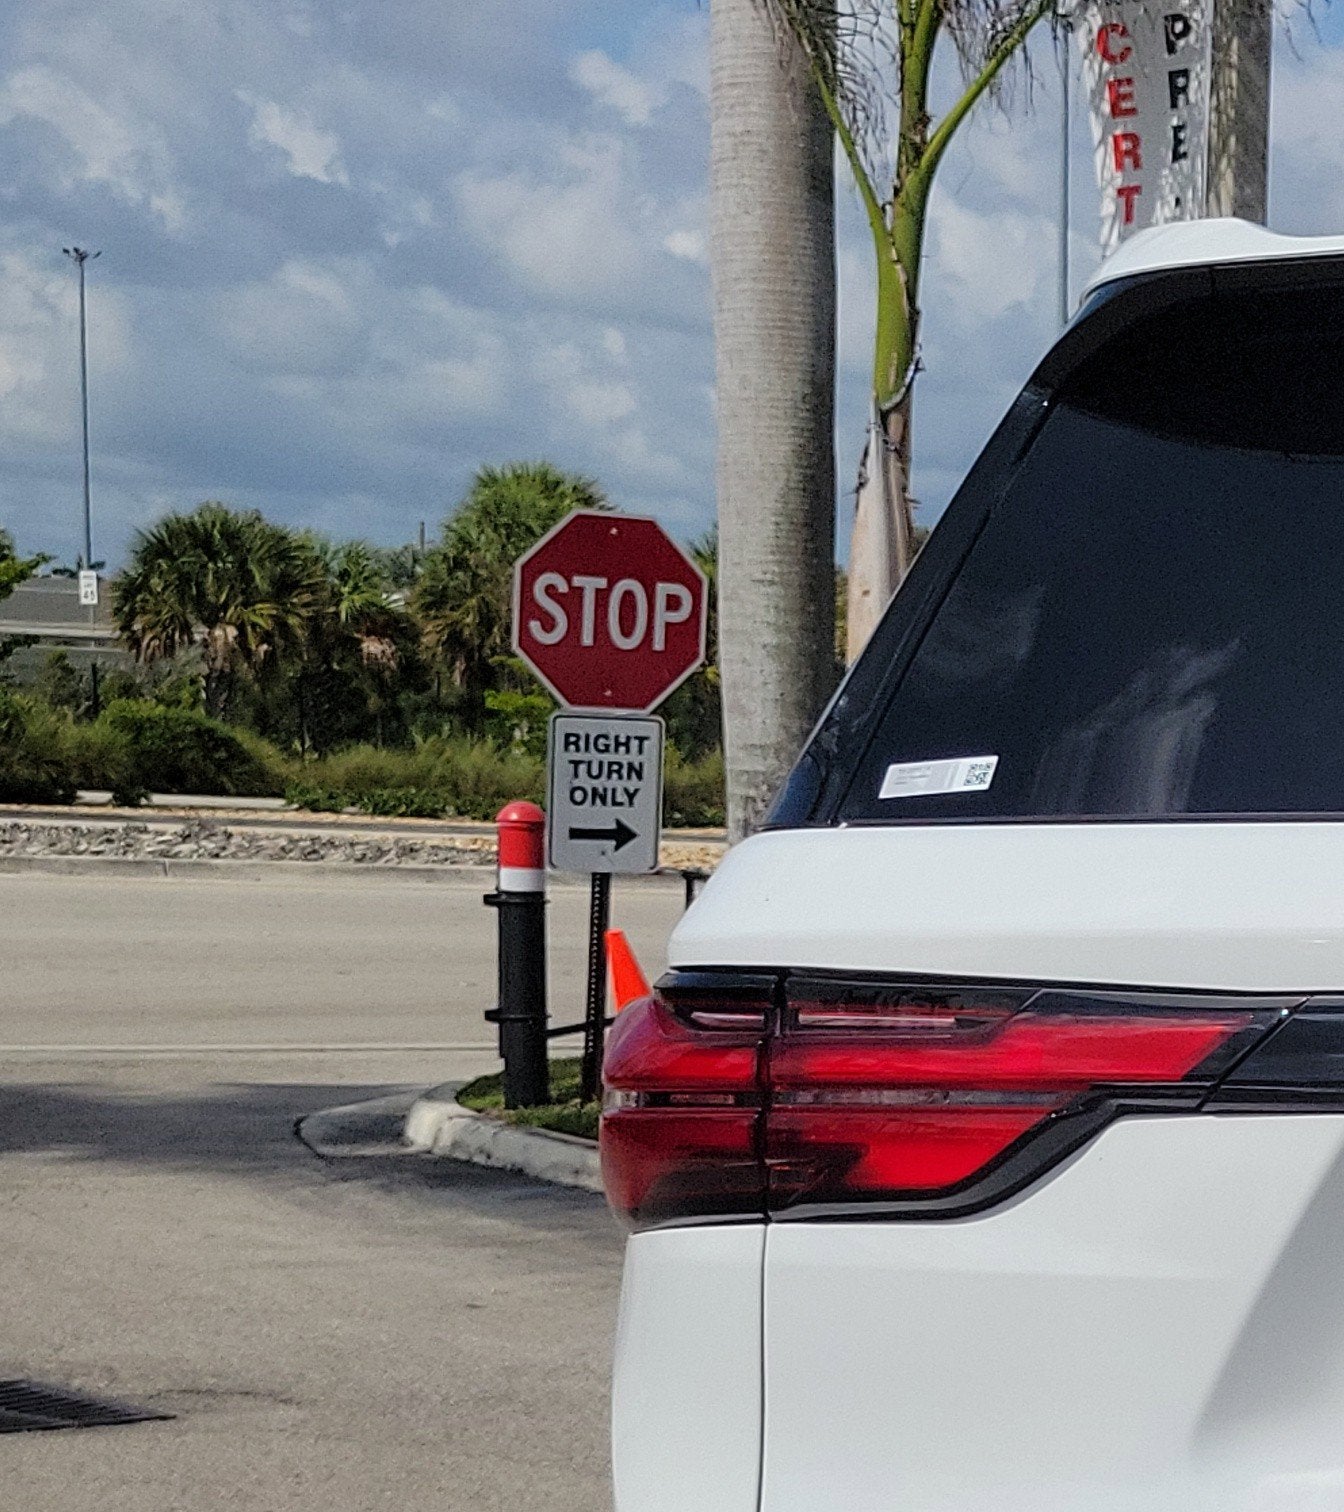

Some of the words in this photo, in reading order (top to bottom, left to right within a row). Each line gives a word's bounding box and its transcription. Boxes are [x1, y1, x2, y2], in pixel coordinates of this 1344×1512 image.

[528, 571, 694, 652] STOP
[563, 733, 650, 755] RIGHT
[568, 759, 644, 782] TURN
[568, 786, 641, 808] ONLY
